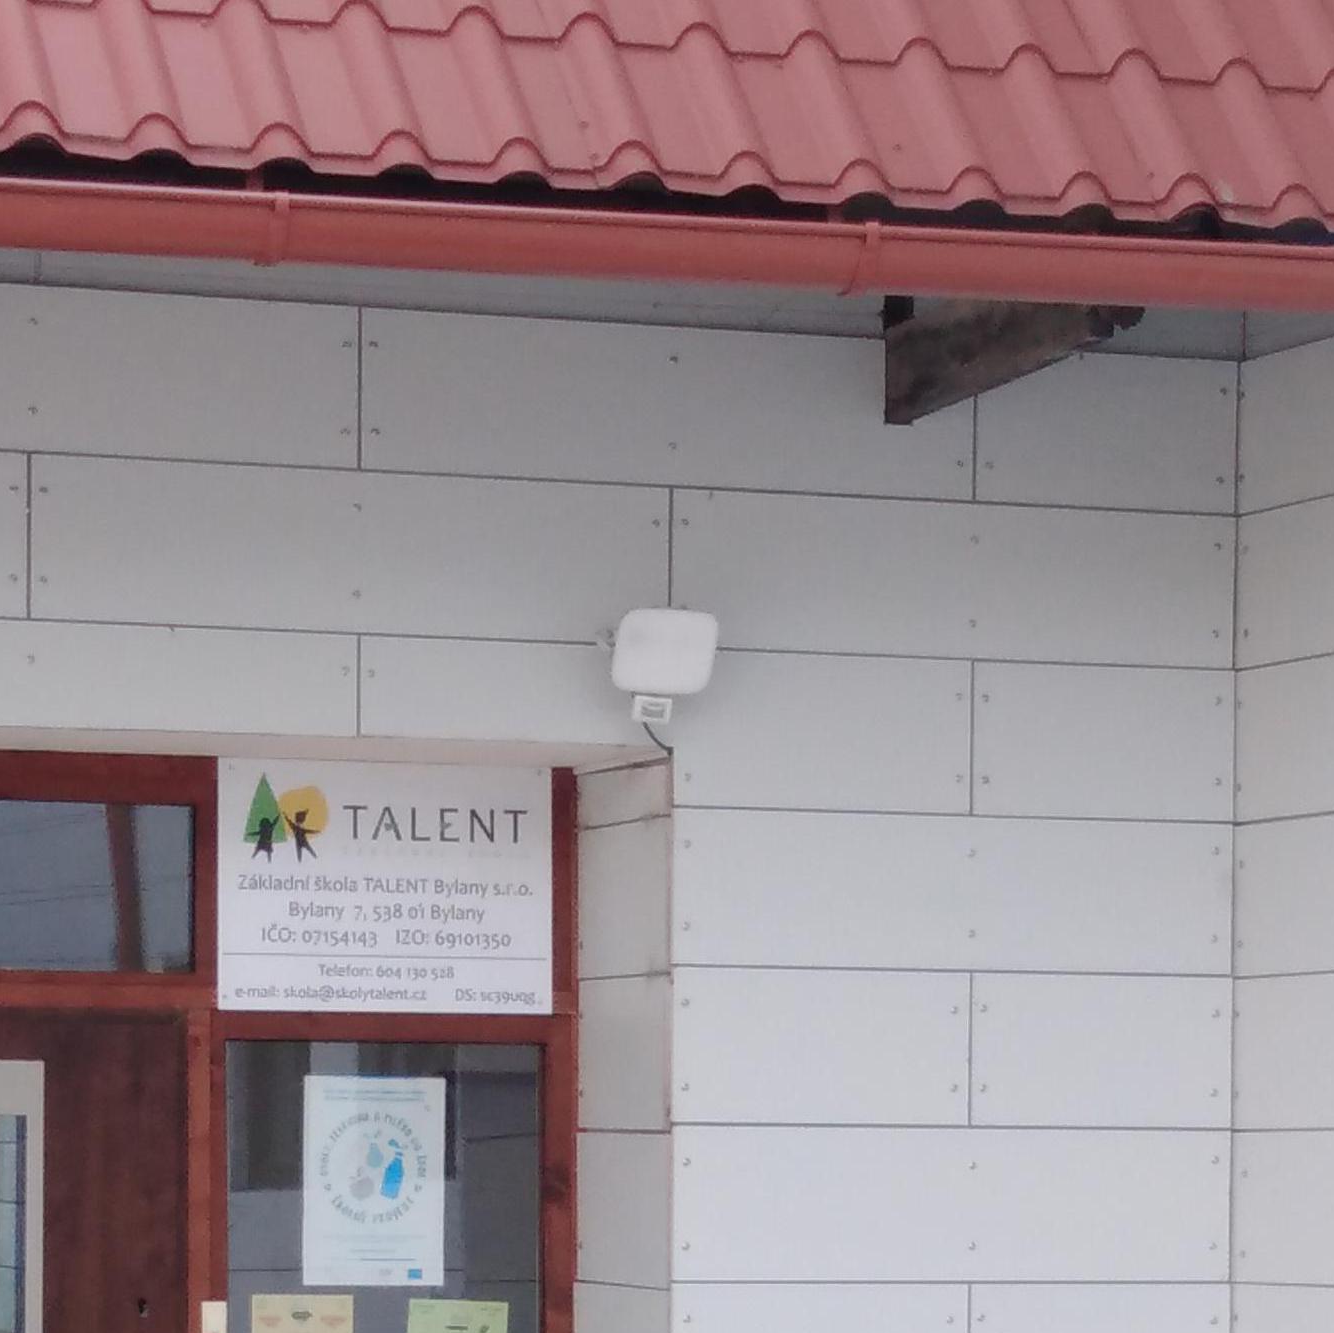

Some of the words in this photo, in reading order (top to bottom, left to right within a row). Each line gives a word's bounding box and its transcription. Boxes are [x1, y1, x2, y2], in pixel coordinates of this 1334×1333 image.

[343, 804, 528, 844] TALENT
[237, 874, 310, 892] Základní
[314, 876, 358, 893] škola
[363, 877, 428, 894] TALENT
[434, 879, 489, 897] Bylany
[288, 901, 345, 920] Bylany
[372, 903, 403, 922] 538
[430, 904, 485, 923] Bylany
[262, 923, 297, 943] IČO:
[302, 929, 378, 948] 07154143
[395, 929, 429, 946] IZO:
[435, 930, 512, 949] 69101350
[318, 963, 373, 977] Telefon:
[376, 965, 402, 979] 604
[235, 986, 280, 999] e-mail:
[455, 989, 477, 1002] DS:
